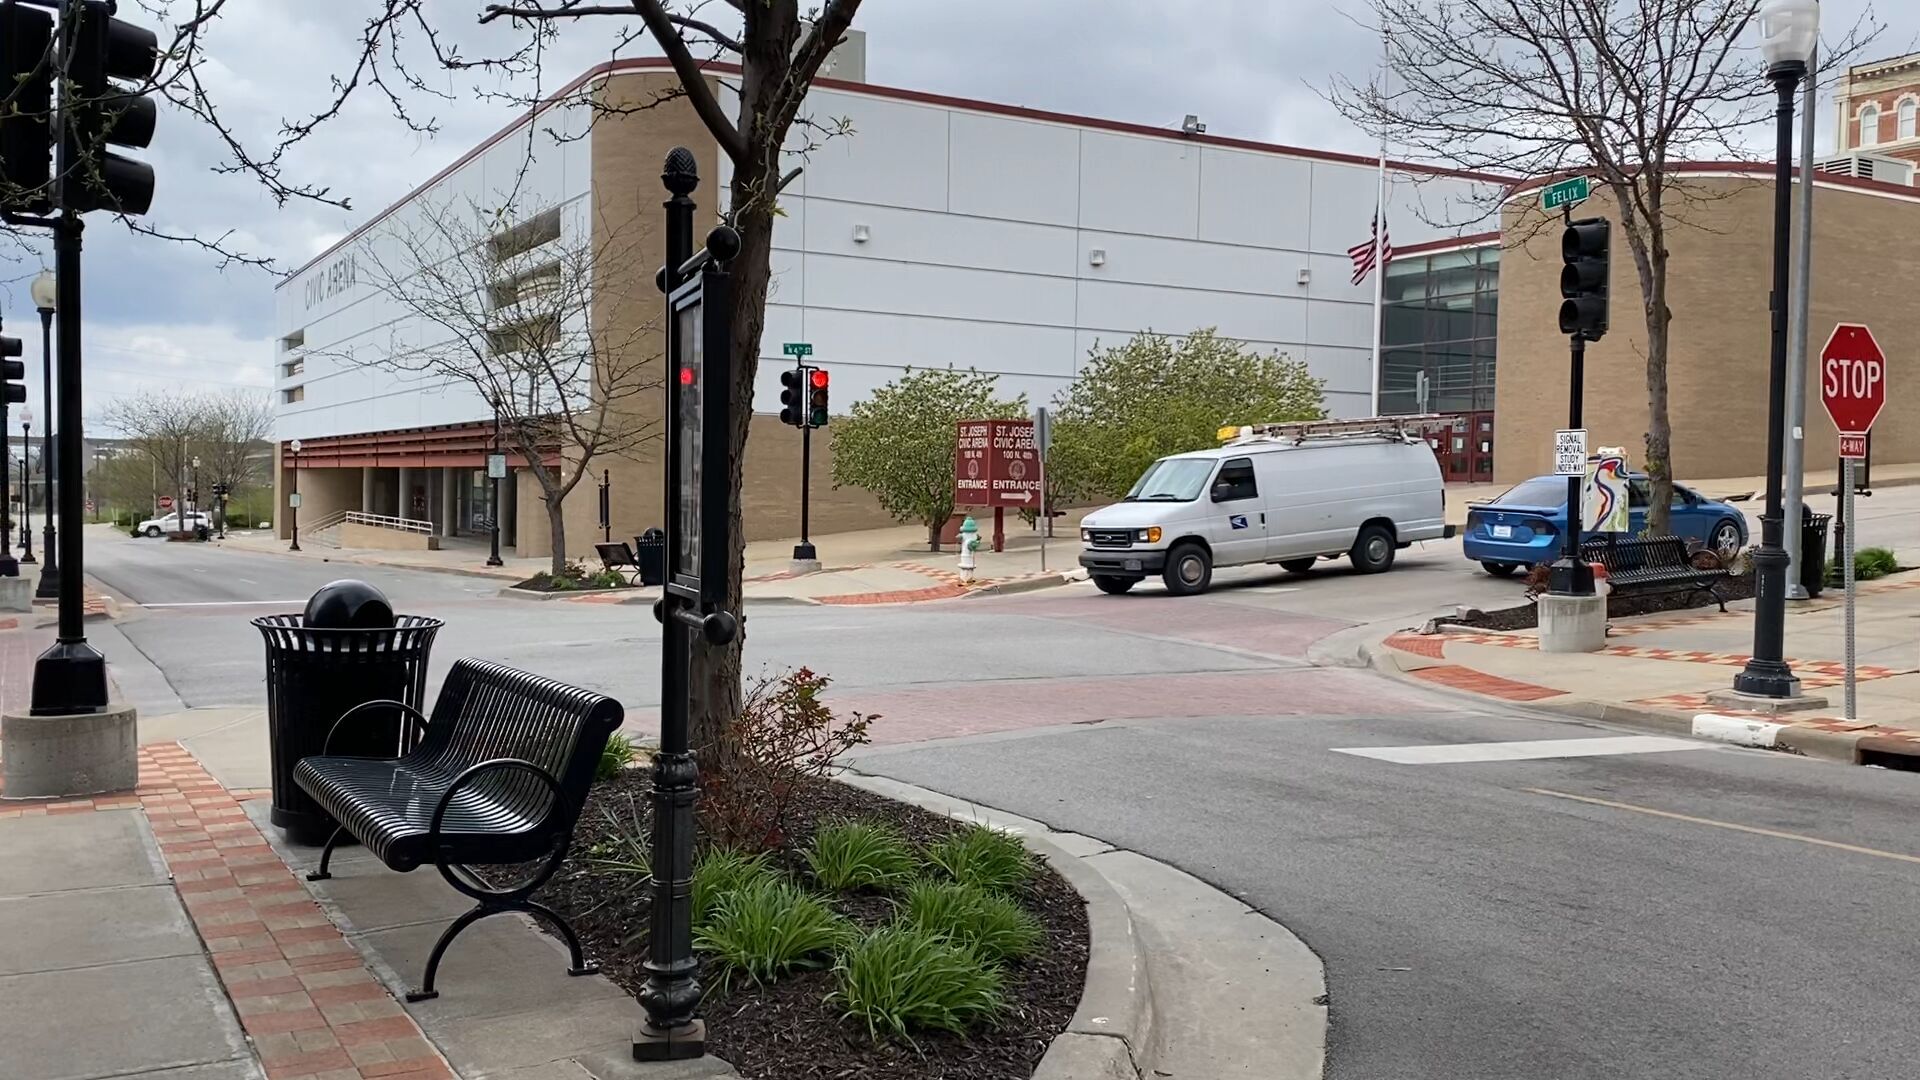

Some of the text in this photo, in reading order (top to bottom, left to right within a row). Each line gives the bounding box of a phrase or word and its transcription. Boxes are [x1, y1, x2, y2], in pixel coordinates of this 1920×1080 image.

[1552, 187, 1578, 204] FELIX
[305, 253, 356, 311] CIVIC ARENA
[1825, 358, 1881, 399] STOP
[968, 425, 987, 437] JOSEPH
[996, 425, 1034, 437] ST. JOSEP
[959, 437, 988, 448] CIVIC ARENA
[993, 437, 1036, 449] CIVIC AREN
[1560, 434, 1581, 444] SIGNAL
[1556, 444, 1584, 454] REMOVAL
[1841, 440, 1864, 453] 4-WAY
[1003, 451, 1013, 459] 100
[1560, 454, 1579, 463] STUDY
[958, 480, 987, 489] ENTRANCE
[993, 480, 1040, 490] ENTRANCE
